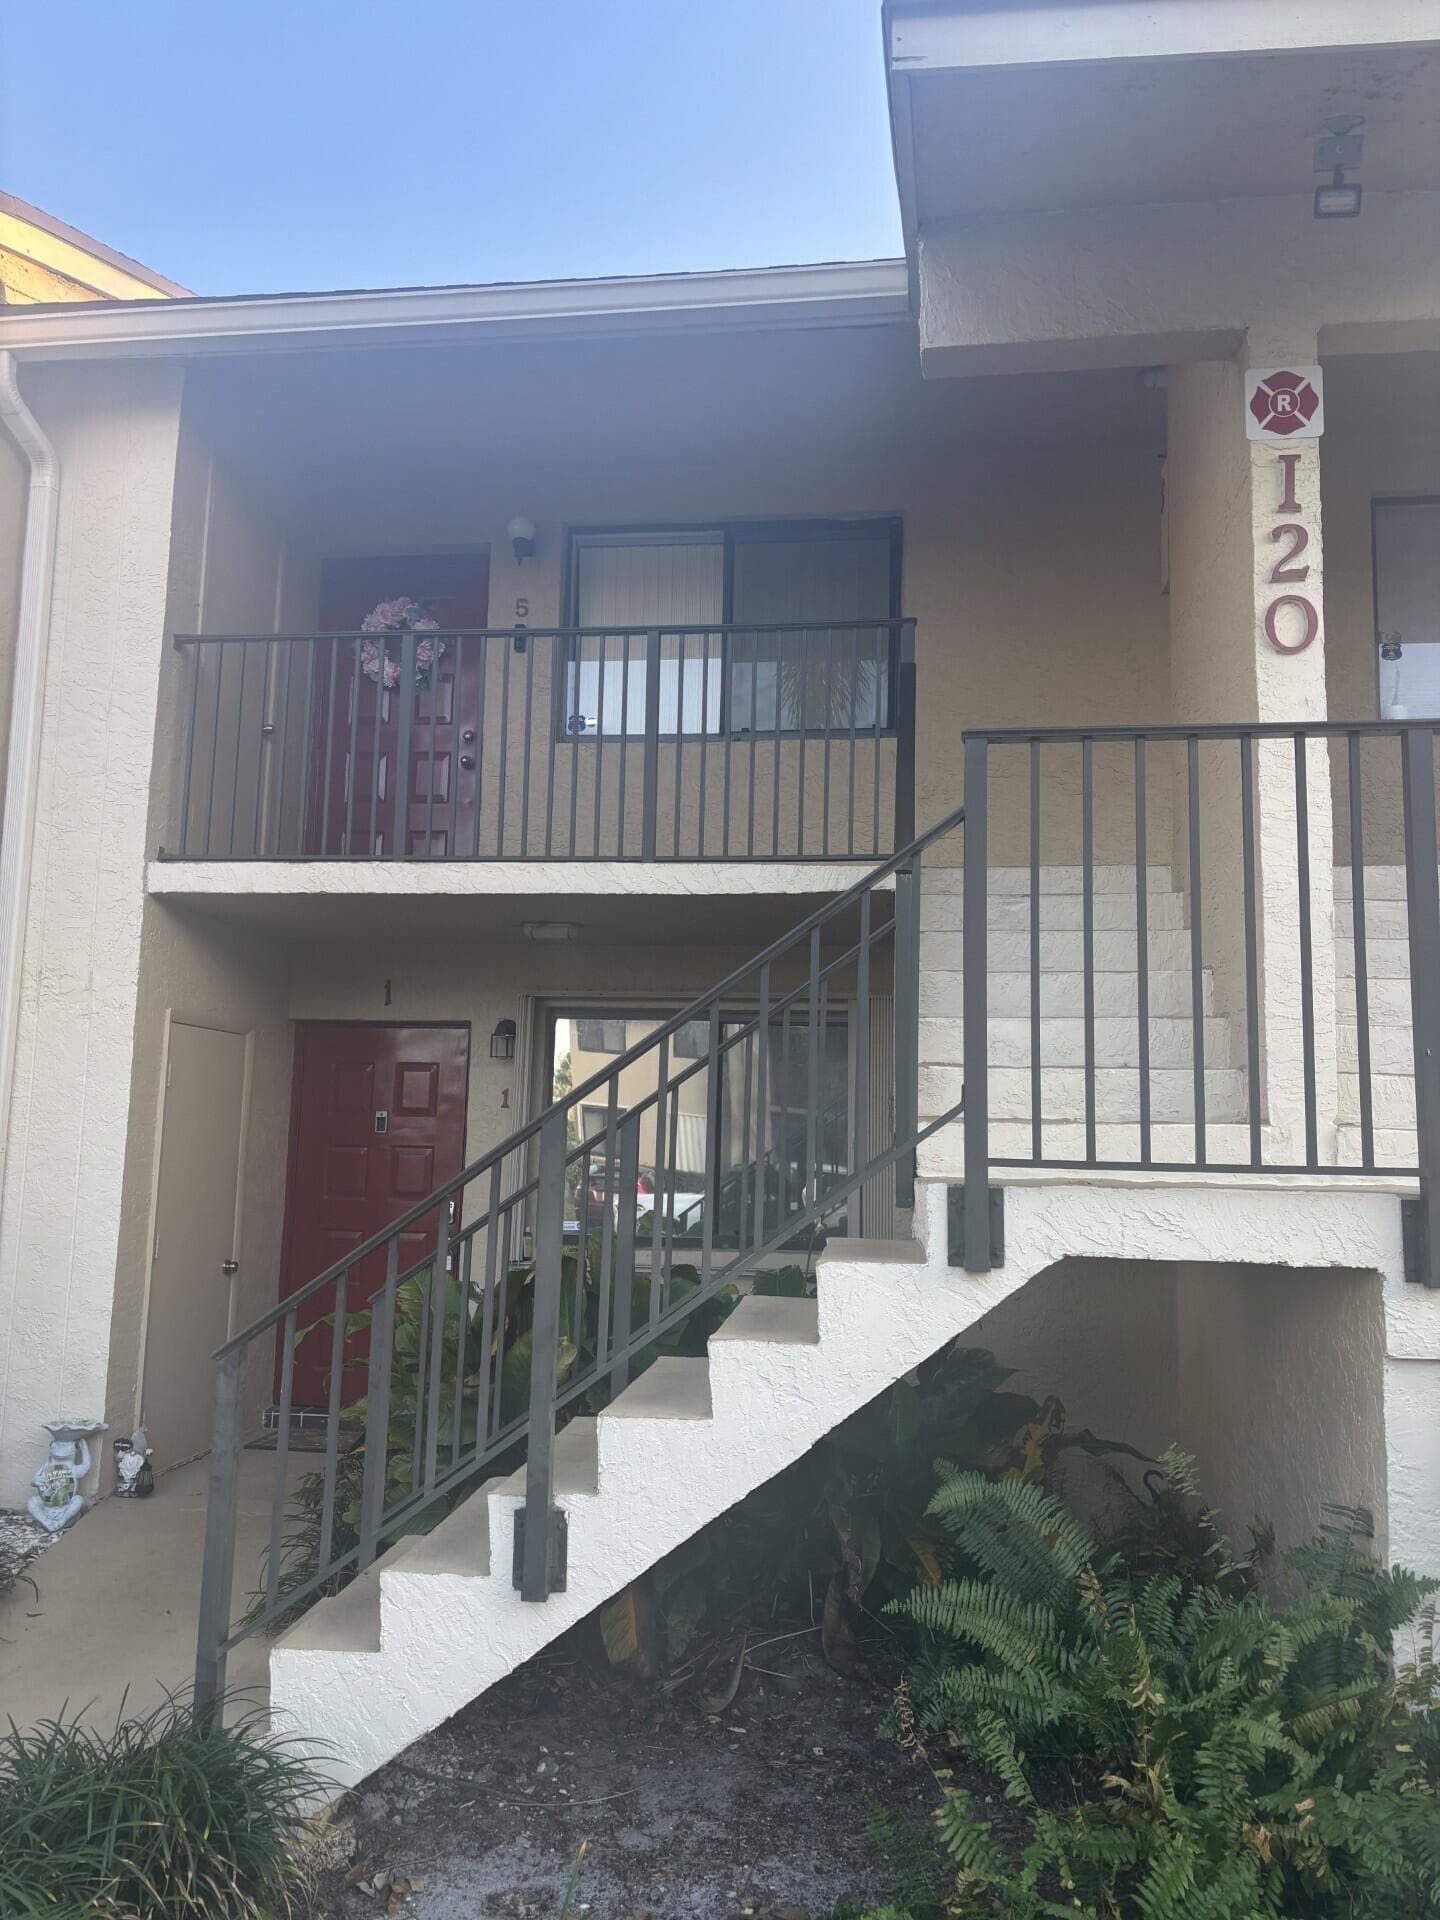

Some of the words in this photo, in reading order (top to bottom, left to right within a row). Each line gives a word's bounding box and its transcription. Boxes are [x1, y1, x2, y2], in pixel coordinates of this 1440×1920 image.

[1277, 394, 1291, 411] R
[515, 598, 529, 618] 5
[500, 1087, 510, 1109] 1
